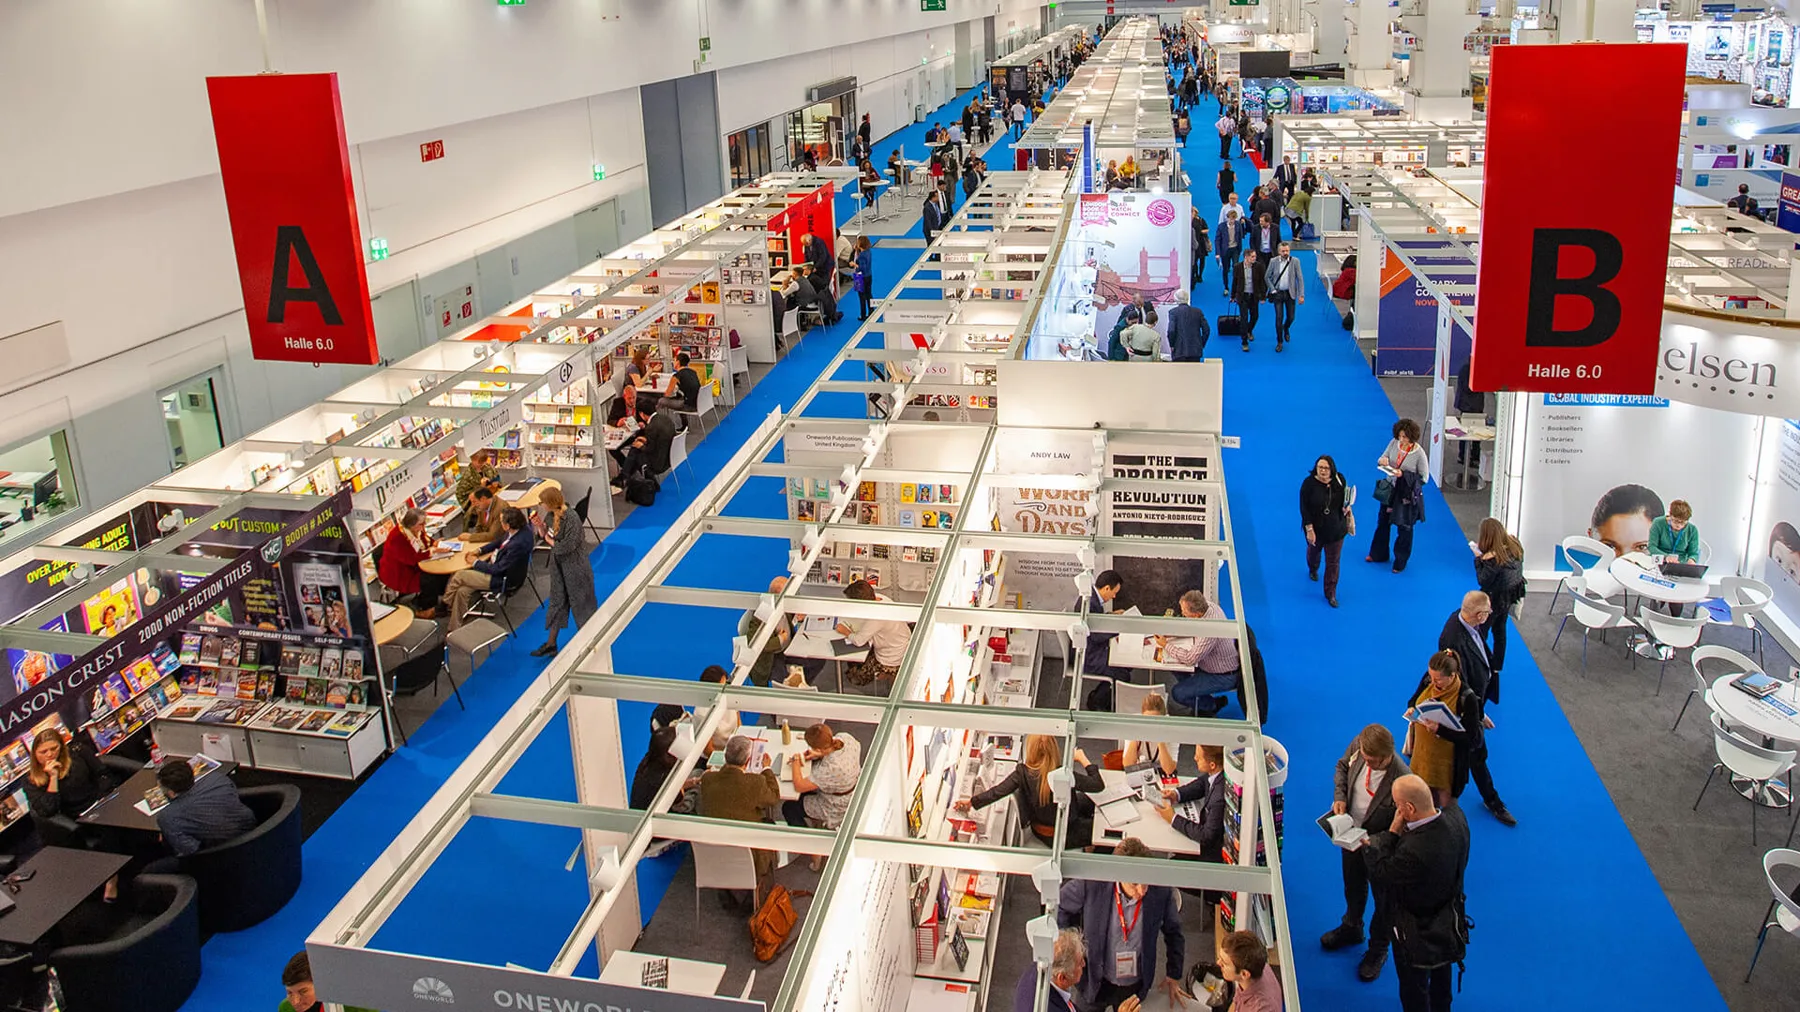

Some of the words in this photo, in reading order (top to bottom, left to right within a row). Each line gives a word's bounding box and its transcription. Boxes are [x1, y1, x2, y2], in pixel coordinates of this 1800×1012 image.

[266, 225, 345, 326] A
[1525, 228, 1623, 348] B
[284, 337, 314, 350] Halle
[315, 338, 334, 350] 6.0
[1527, 363, 1571, 379] Halle
[1575, 364, 1602, 379] 6.0
[1664, 342, 1778, 388] elsen
[1549, 393, 1580, 404] GLOBAL
[1580, 393, 1621, 405] INDUSTRY
[1622, 394, 1666, 406] EXPERTISE
[1030, 451, 1052, 459] ANDY
[1053, 452, 1071, 460] LAW
[1147, 455, 1173, 467] THE
[1045, 503, 1087, 518] AND
[1112, 512, 1143, 520] ANTONIO
[1143, 513, 1206, 522] NIETO-RODRIGUEZ
[241, 520, 280, 535] CUSTOM
[1014, 509, 1087, 536] DAYS
[102, 523, 128, 546] ADULT
[285, 522, 309, 547] BOOTH
[310, 517, 316, 531] #
[263, 541, 280, 560] MC
[26, 562, 53, 584] OVER
[138, 620, 164, 645] 2000
[163, 579, 223, 627] NON-FICTION
[223, 560, 253, 588] TITLES
[199, 625, 218, 633] DRUGS
[238, 629, 282, 640] CONTEMPORARY
[282, 633, 301, 642] ISSUES
[314, 636, 343, 645] SELF-HELP
[67, 641, 127, 689] CREST
[413, 993, 455, 1003] ONEWORLD
[494, 990, 648, 1012] ONEWOR
